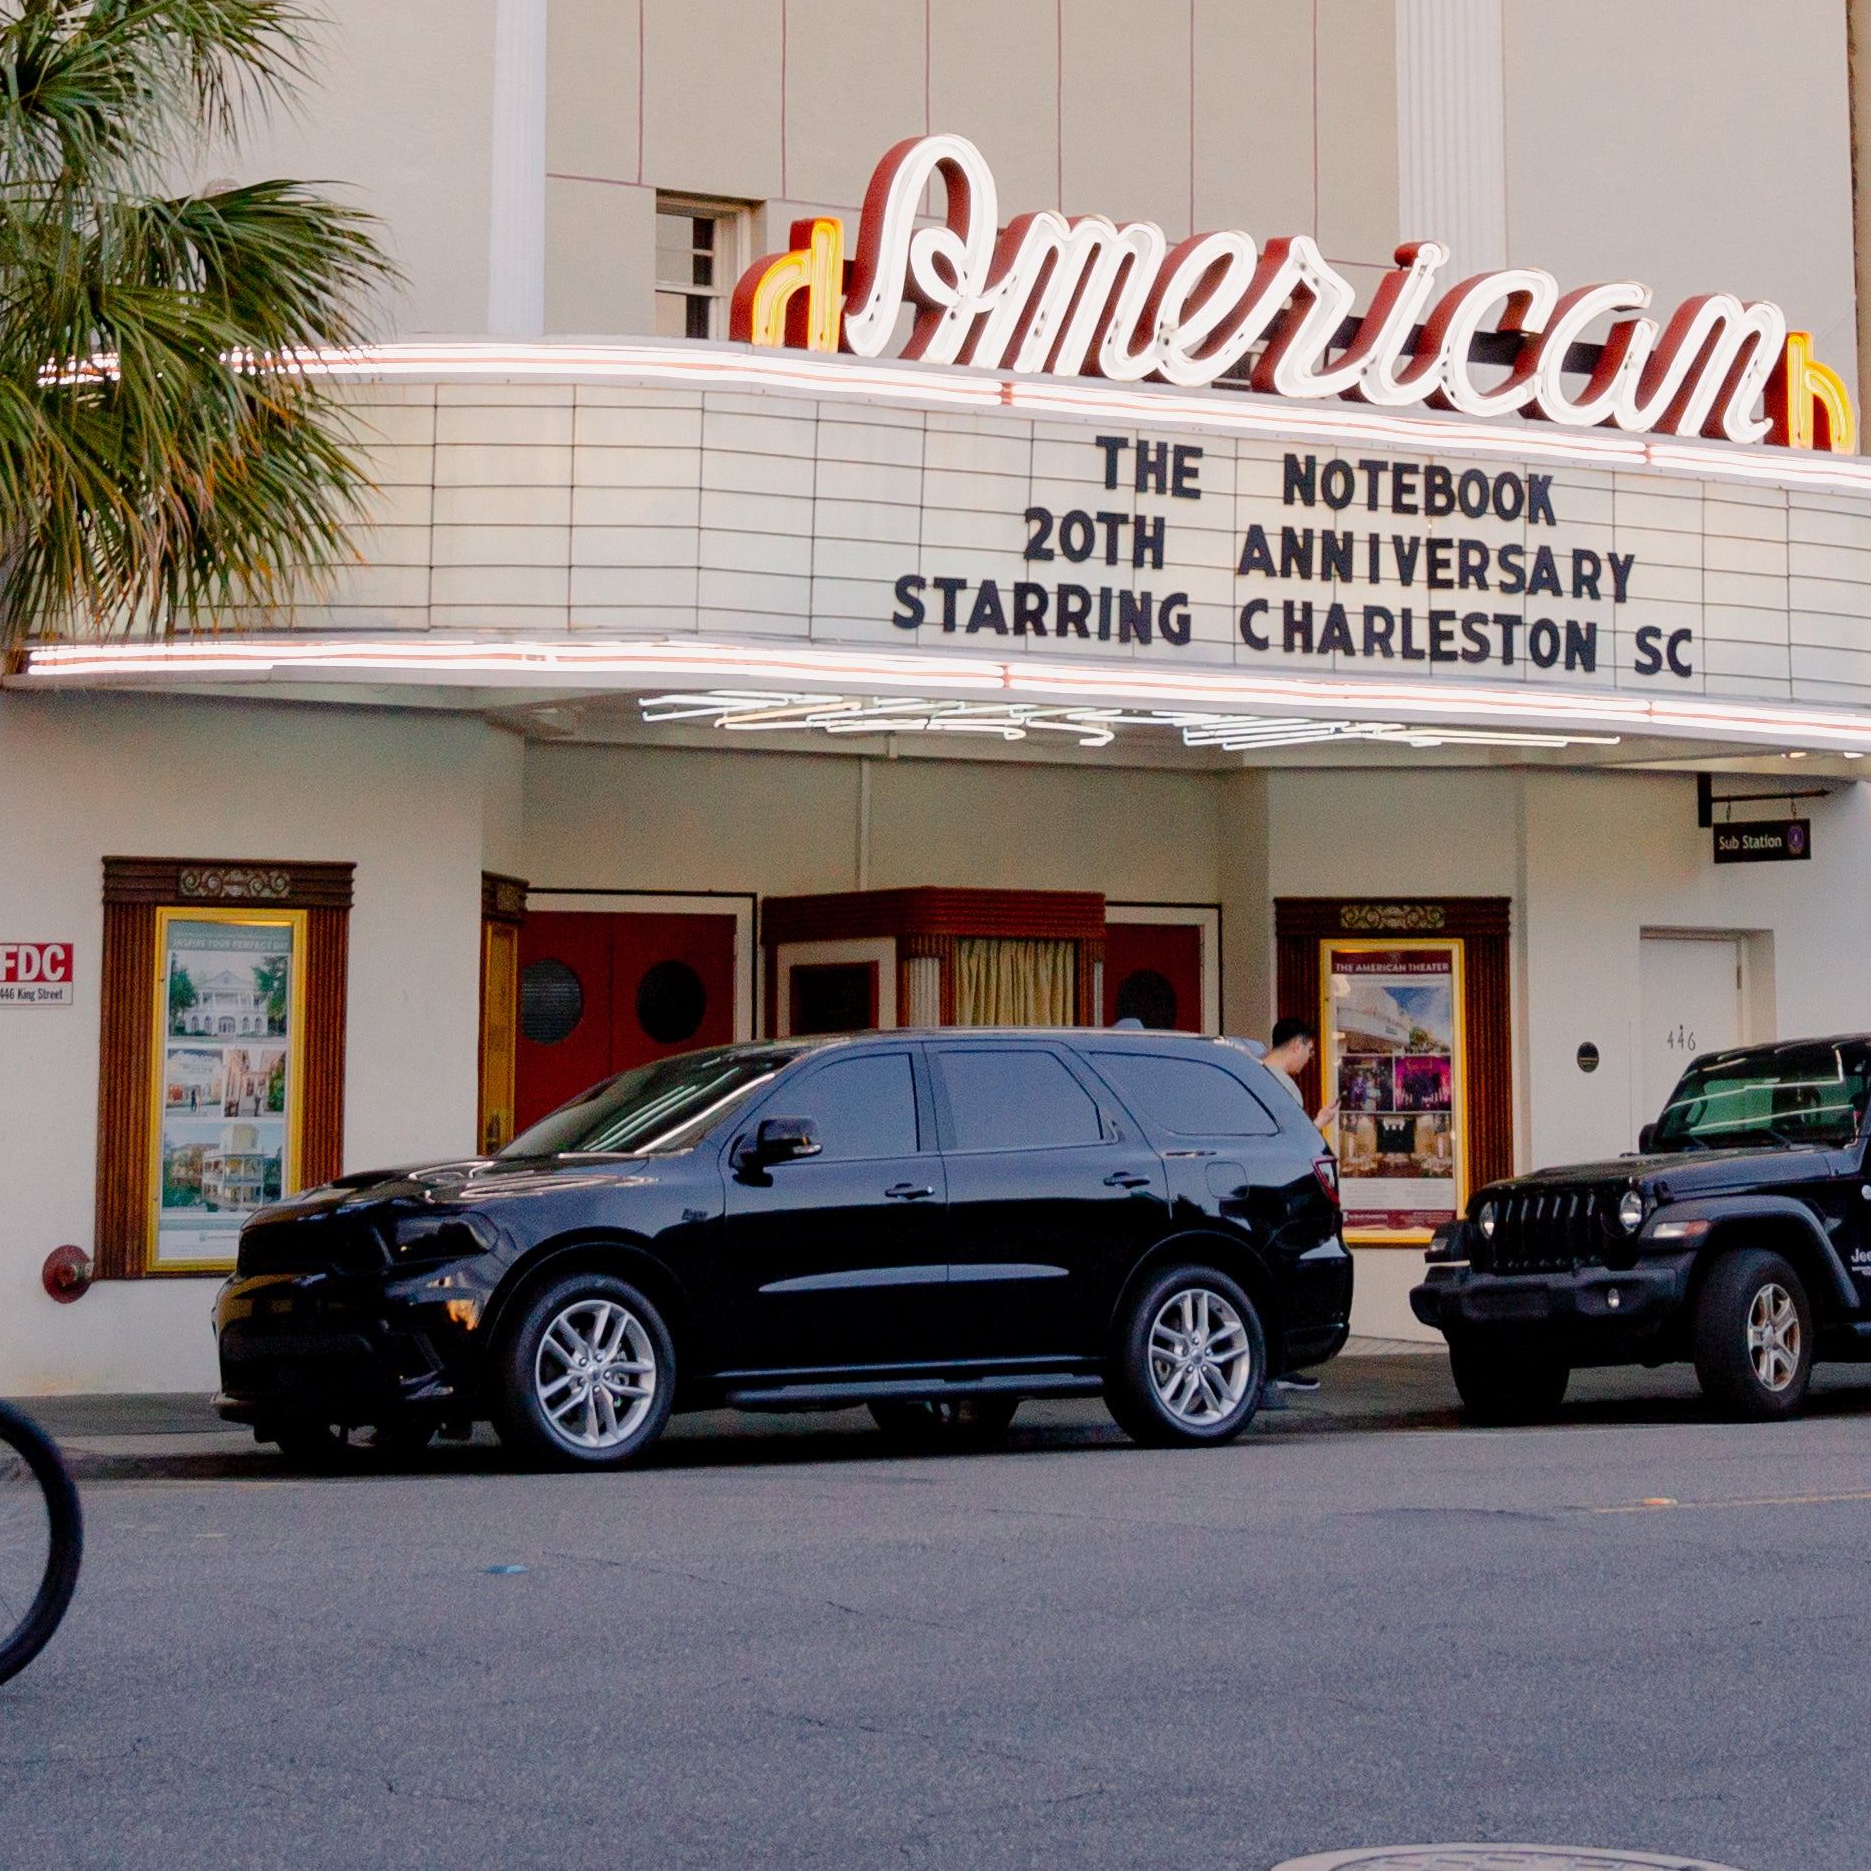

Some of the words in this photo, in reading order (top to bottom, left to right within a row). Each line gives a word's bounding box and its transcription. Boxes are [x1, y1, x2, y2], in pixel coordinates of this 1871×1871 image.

[843, 133, 1790, 444] American
[1095, 436, 1203, 500] THE
[1283, 453, 1557, 526] NOTEBOOK
[1023, 506, 1165, 569] 20TH
[1237, 524, 1635, 603] ANNIVERSARY
[892, 574, 1191, 646] STARRING
[1239, 598, 1597, 673] CHARLESTON
[1634, 626, 1693, 678] SC
[1719, 835, 1740, 851] Sub
[1742, 833, 1783, 850] Station
[0, 987, 15, 1000] 446
[18, 987, 35, 1002] King
[38, 987, 63, 1000] Street
[1336, 963, 1353, 972] THE
[1356, 963, 1406, 972] AMERICAN
[1408, 962, 1449, 972] THEATER
[1667, 1030, 1696, 1051] 446
